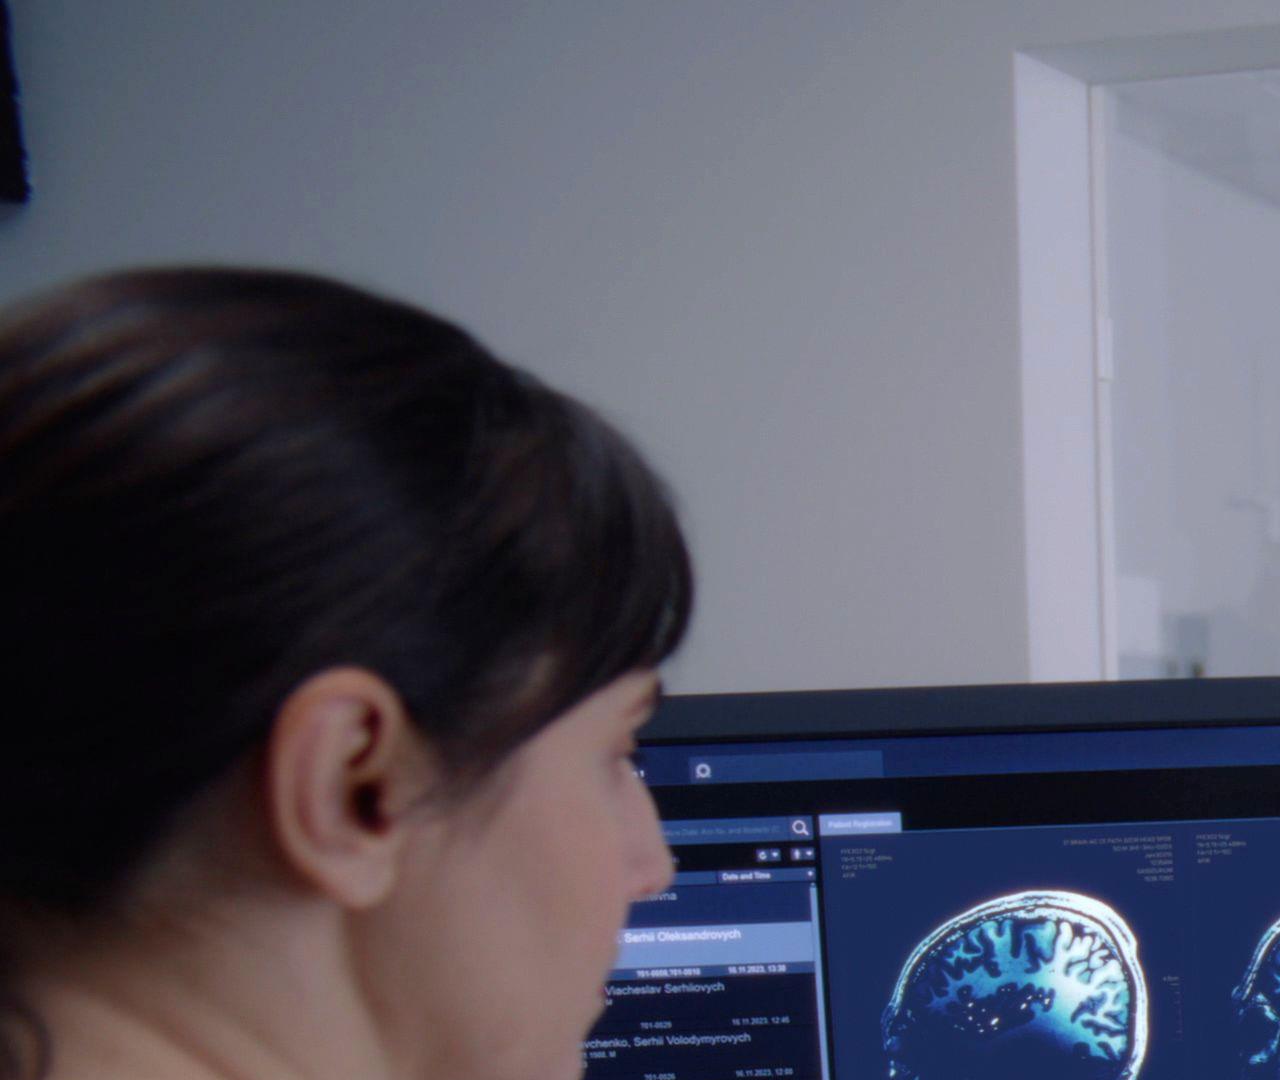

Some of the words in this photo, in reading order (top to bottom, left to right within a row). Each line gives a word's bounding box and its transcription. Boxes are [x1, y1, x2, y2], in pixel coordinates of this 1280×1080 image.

[722, 872, 738, 881] Date
[740, 872, 753, 880] and
[755, 870, 771, 880] Time
[657, 929, 741, 943] Oleksandrovych
[577, 1037, 631, 1050] vchenko,
[634, 1037, 664, 1047] Serhii
[666, 1033, 751, 1047] Volodymyrovych
